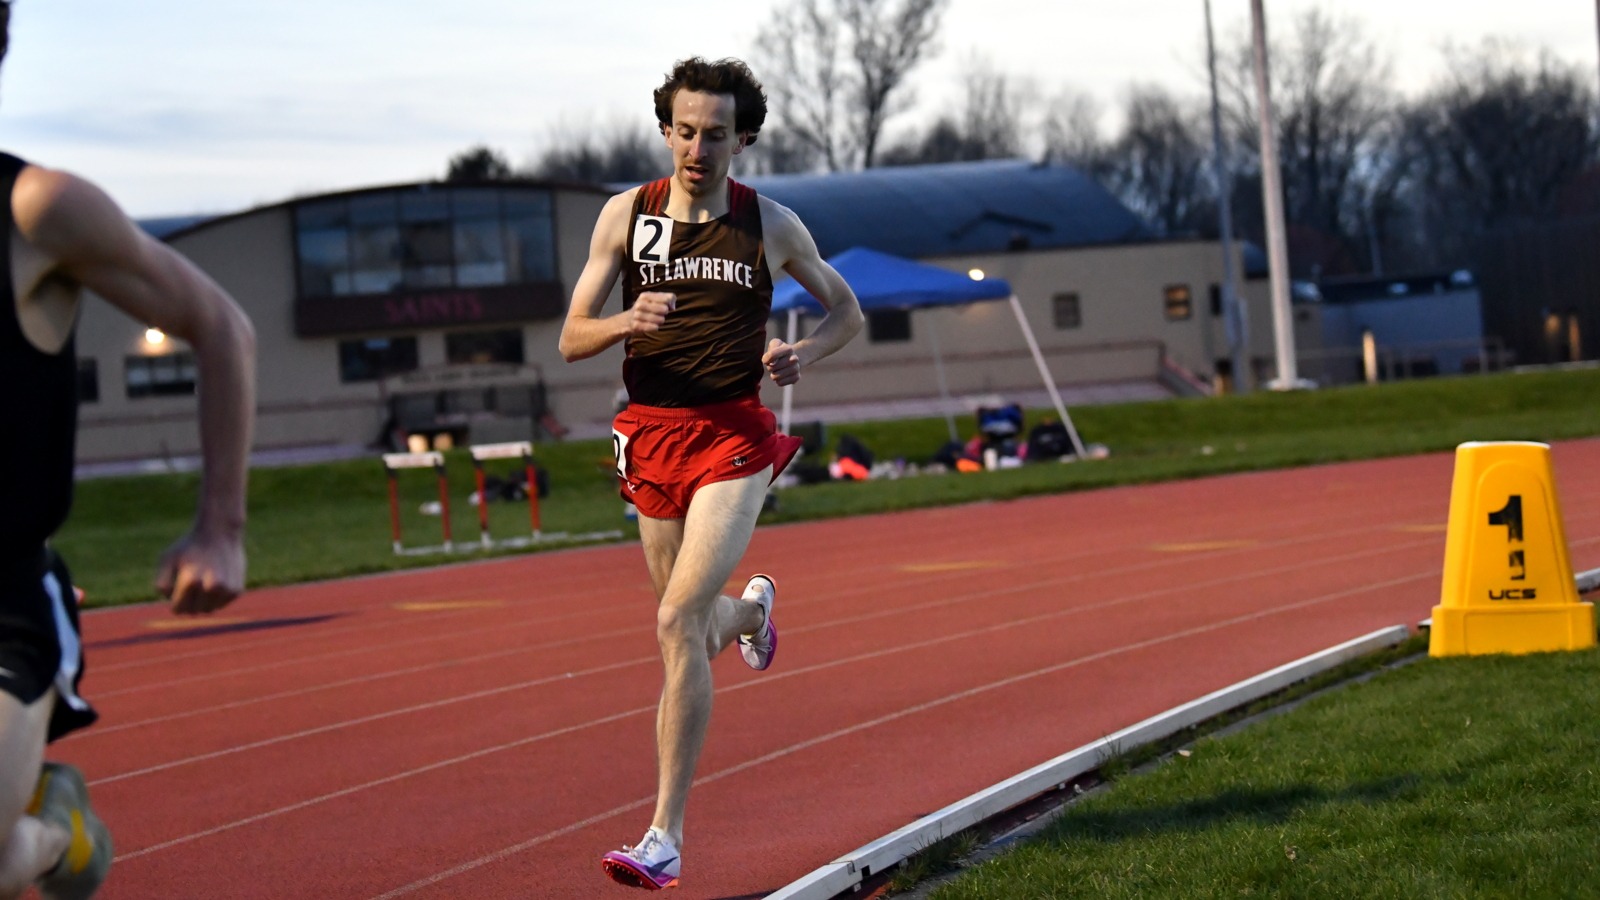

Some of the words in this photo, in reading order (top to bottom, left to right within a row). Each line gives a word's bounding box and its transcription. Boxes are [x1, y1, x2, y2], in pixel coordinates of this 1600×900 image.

[638, 219, 664, 262] 2
[639, 263, 661, 286] ST.
[664, 256, 753, 289] LAWRENCE
[1489, 588, 1537, 601] UCS
